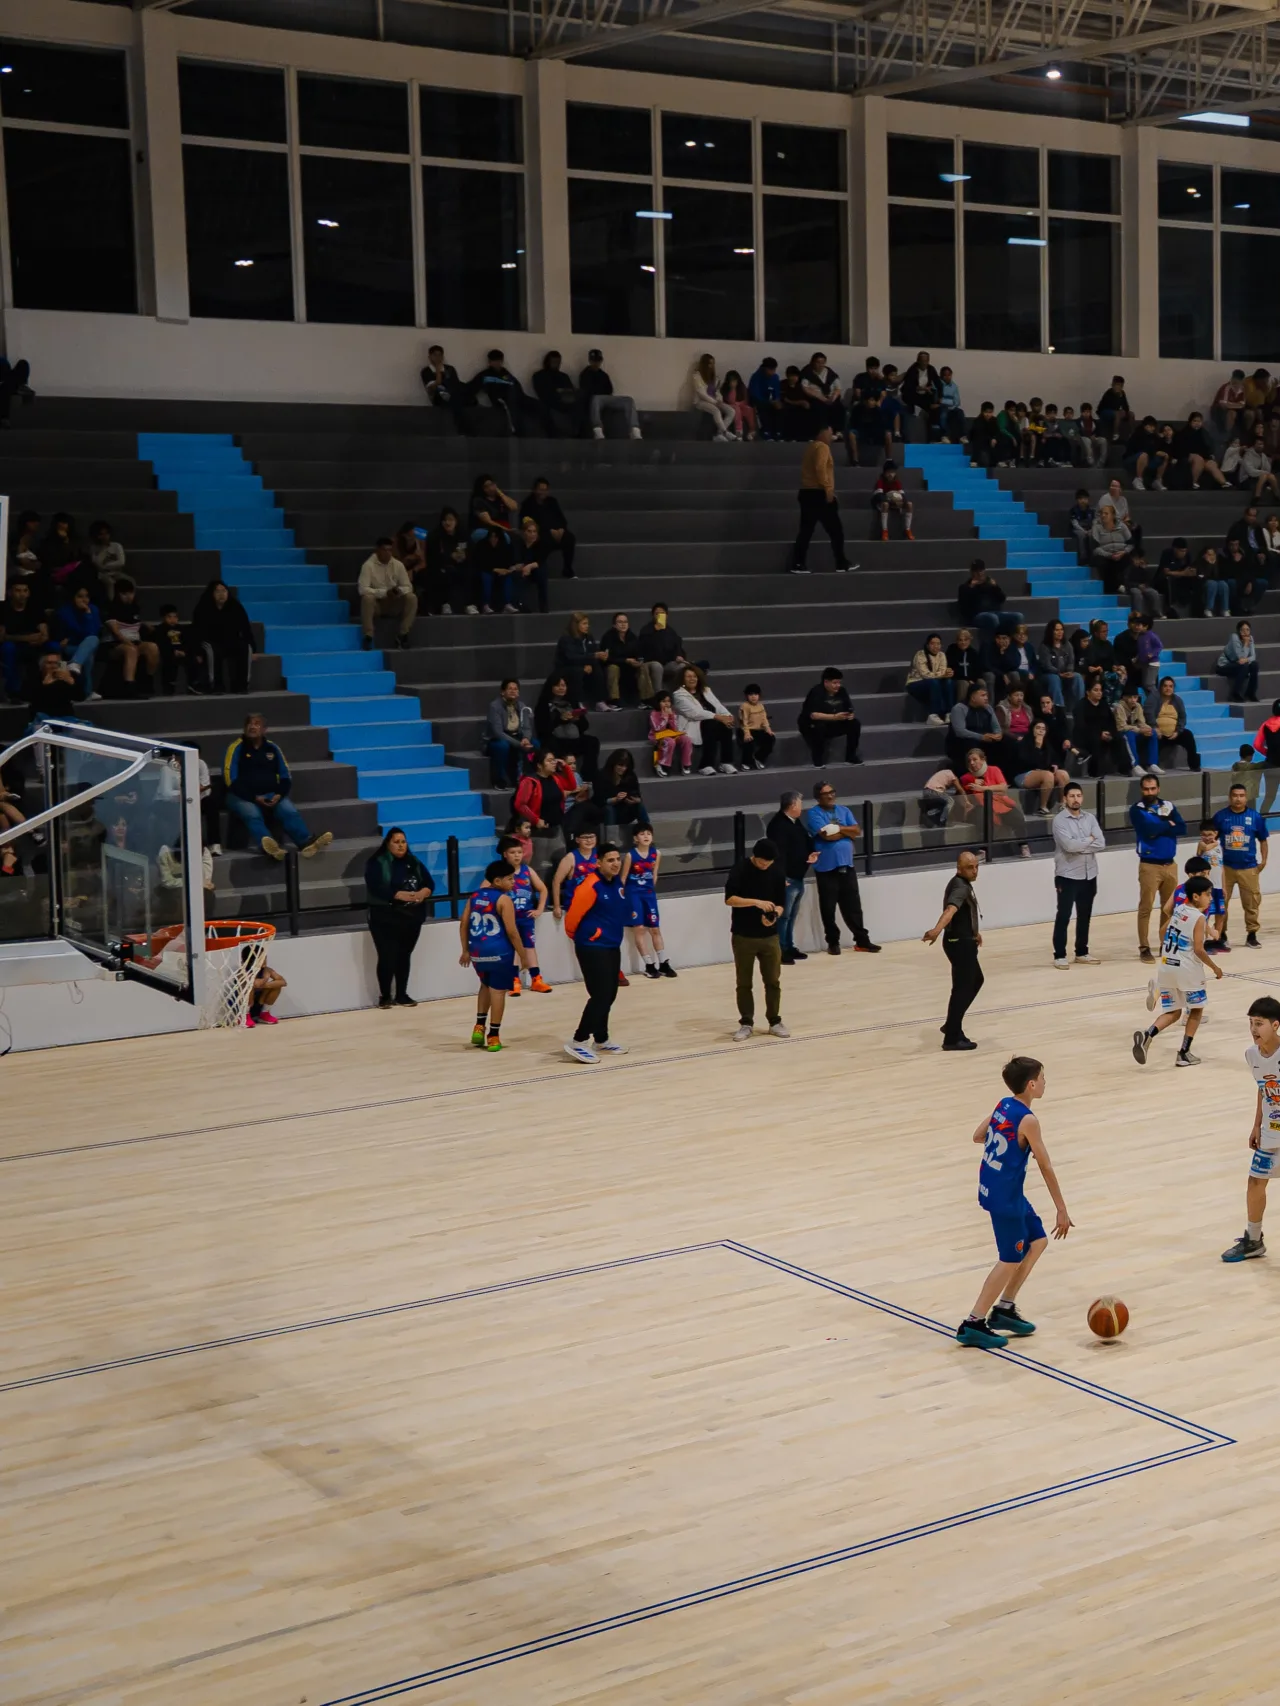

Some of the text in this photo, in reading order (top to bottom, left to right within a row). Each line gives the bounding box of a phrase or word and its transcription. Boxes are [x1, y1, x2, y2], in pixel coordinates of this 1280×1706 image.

[469, 911, 501, 937] 30
[1165, 925, 1182, 955] 57
[984, 1125, 1008, 1171] 22
